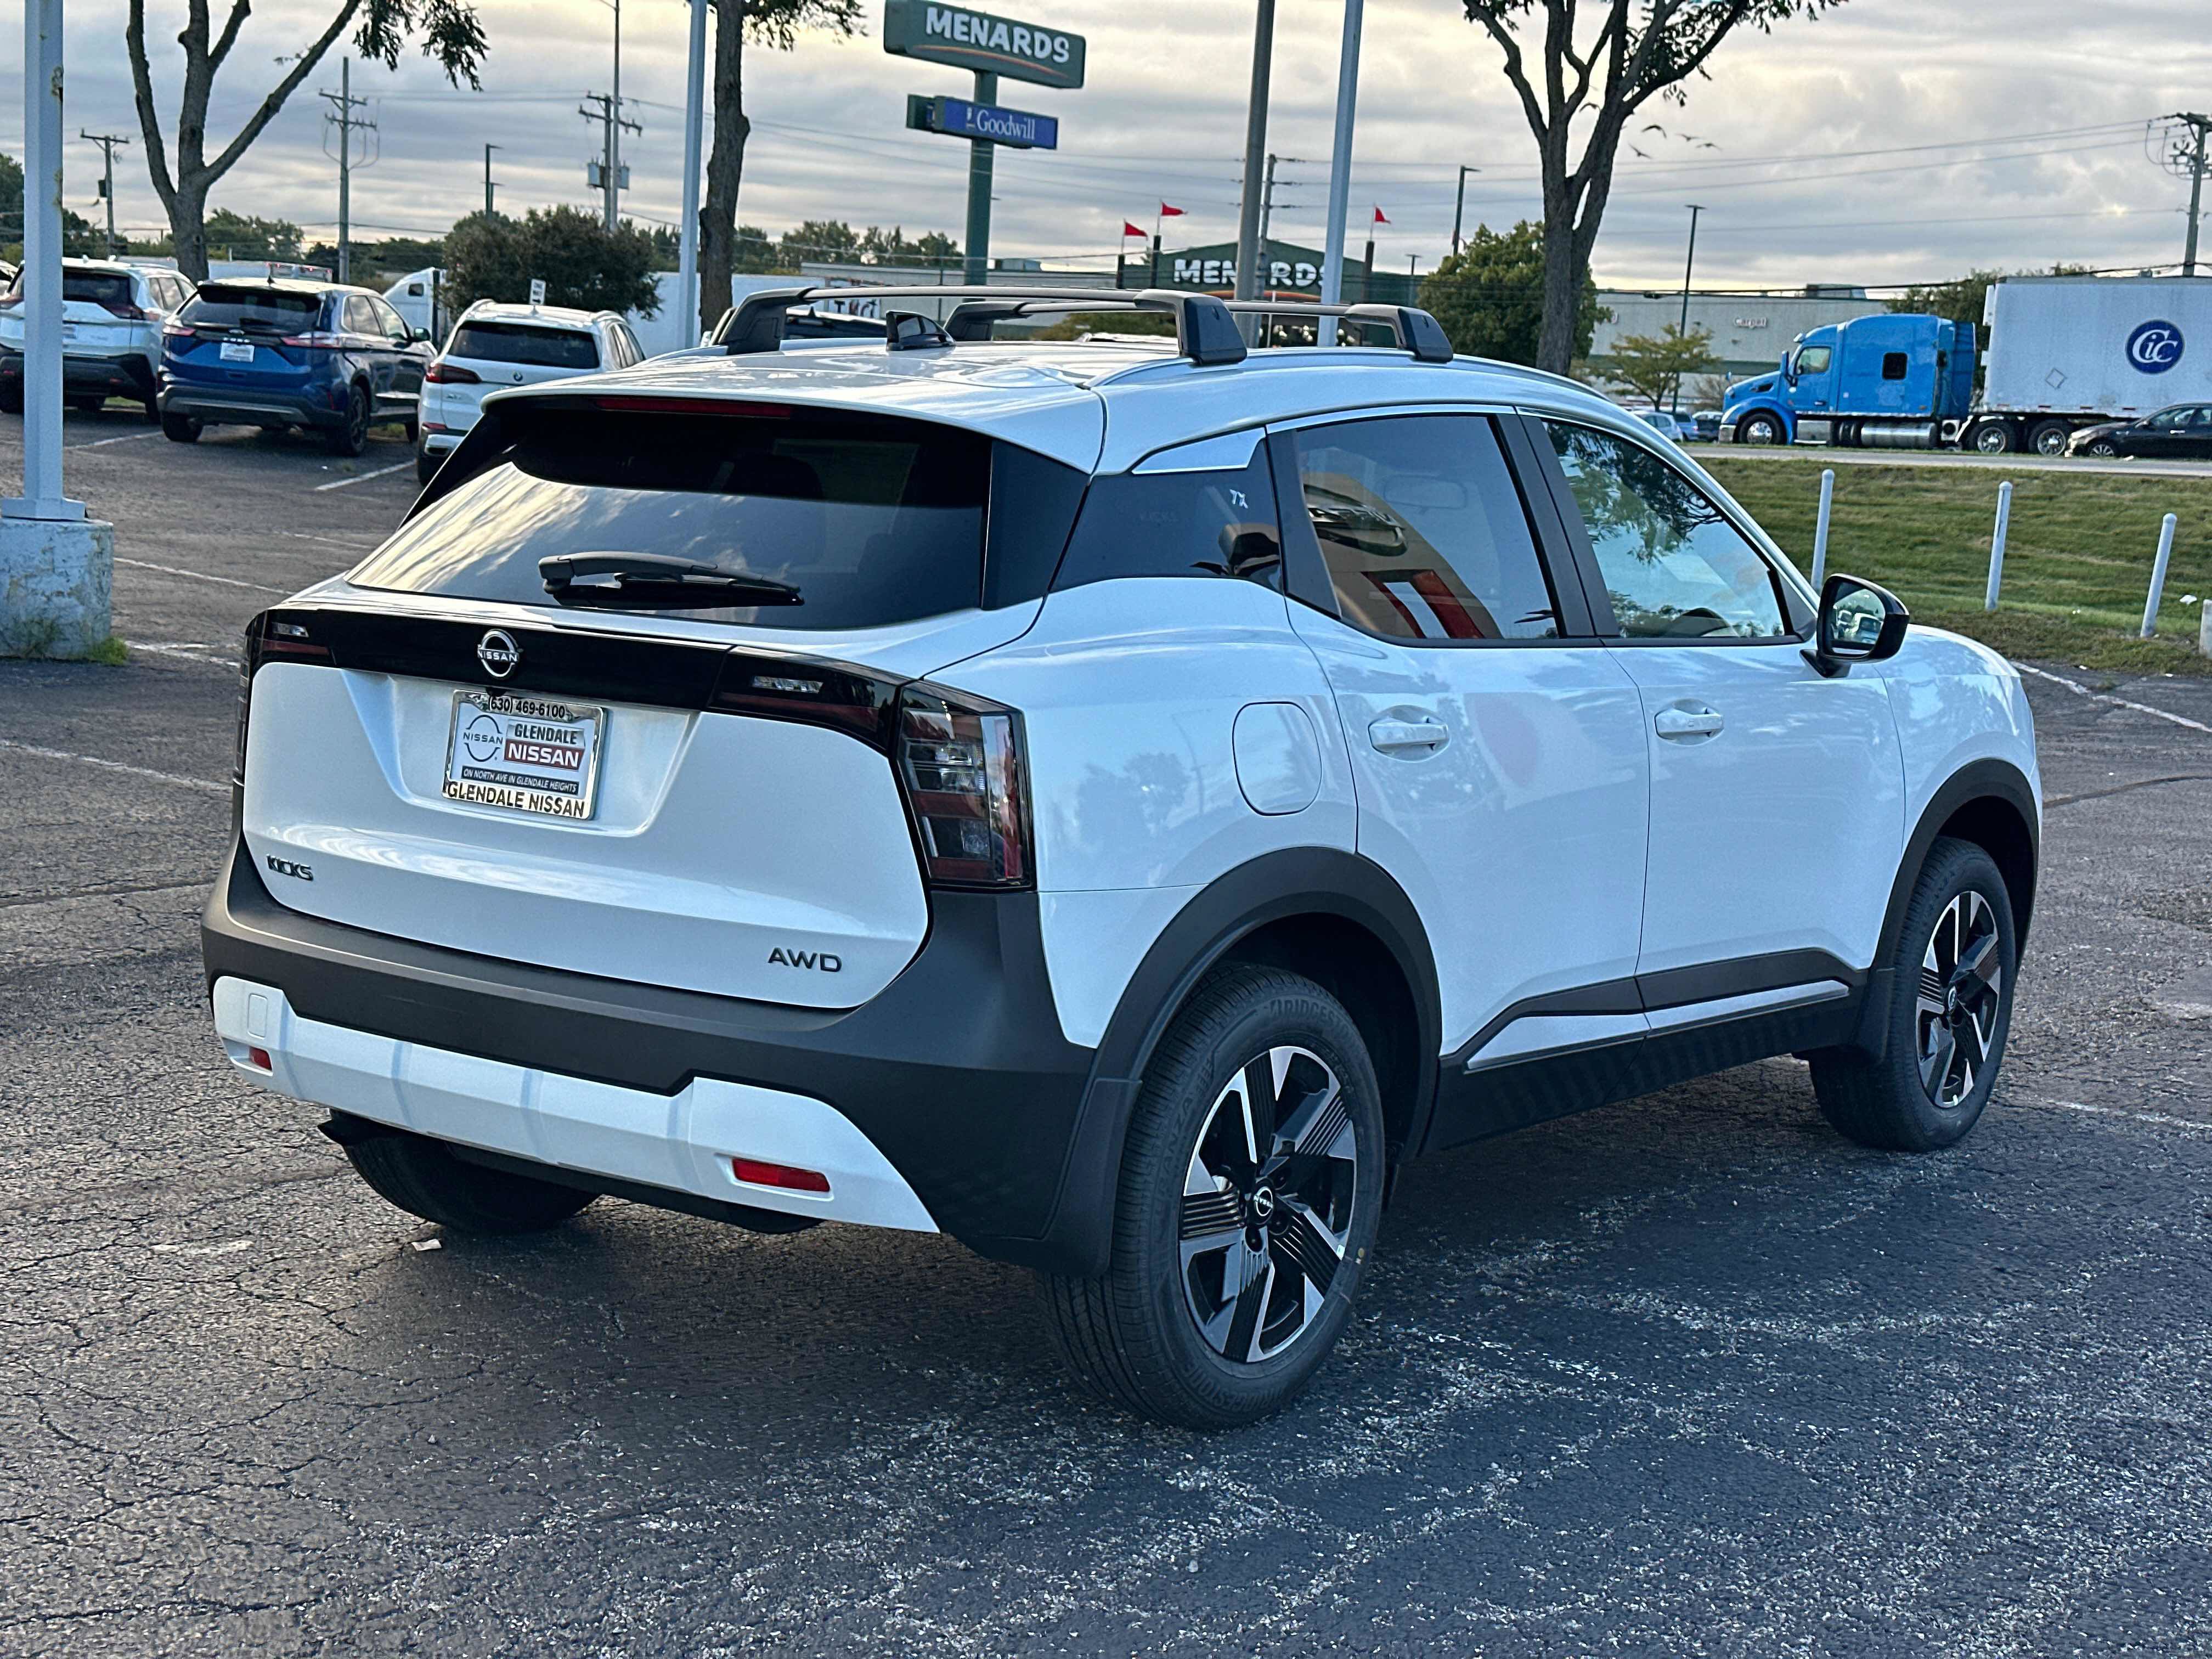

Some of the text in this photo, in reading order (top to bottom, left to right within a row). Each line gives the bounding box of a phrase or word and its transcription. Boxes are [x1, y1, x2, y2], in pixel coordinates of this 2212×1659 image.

[926, 7, 1069, 63] MENARDS
[977, 110, 1035, 140] Goodwill
[1173, 259, 1324, 286] MENRD
[477, 649, 518, 662] NISSAN
[488, 697, 566, 718] (630) 469-6100
[463, 732, 503, 744] NISSAN
[515, 723, 577, 745] GLENDALE
[508, 743, 579, 767] NISSAN
[464, 769, 577, 792] ON NORTH AVE IN GLENDALE HEIGHTS
[447, 781, 585, 817] GLENDALE NISSAN
[768, 947, 842, 973] AWD
